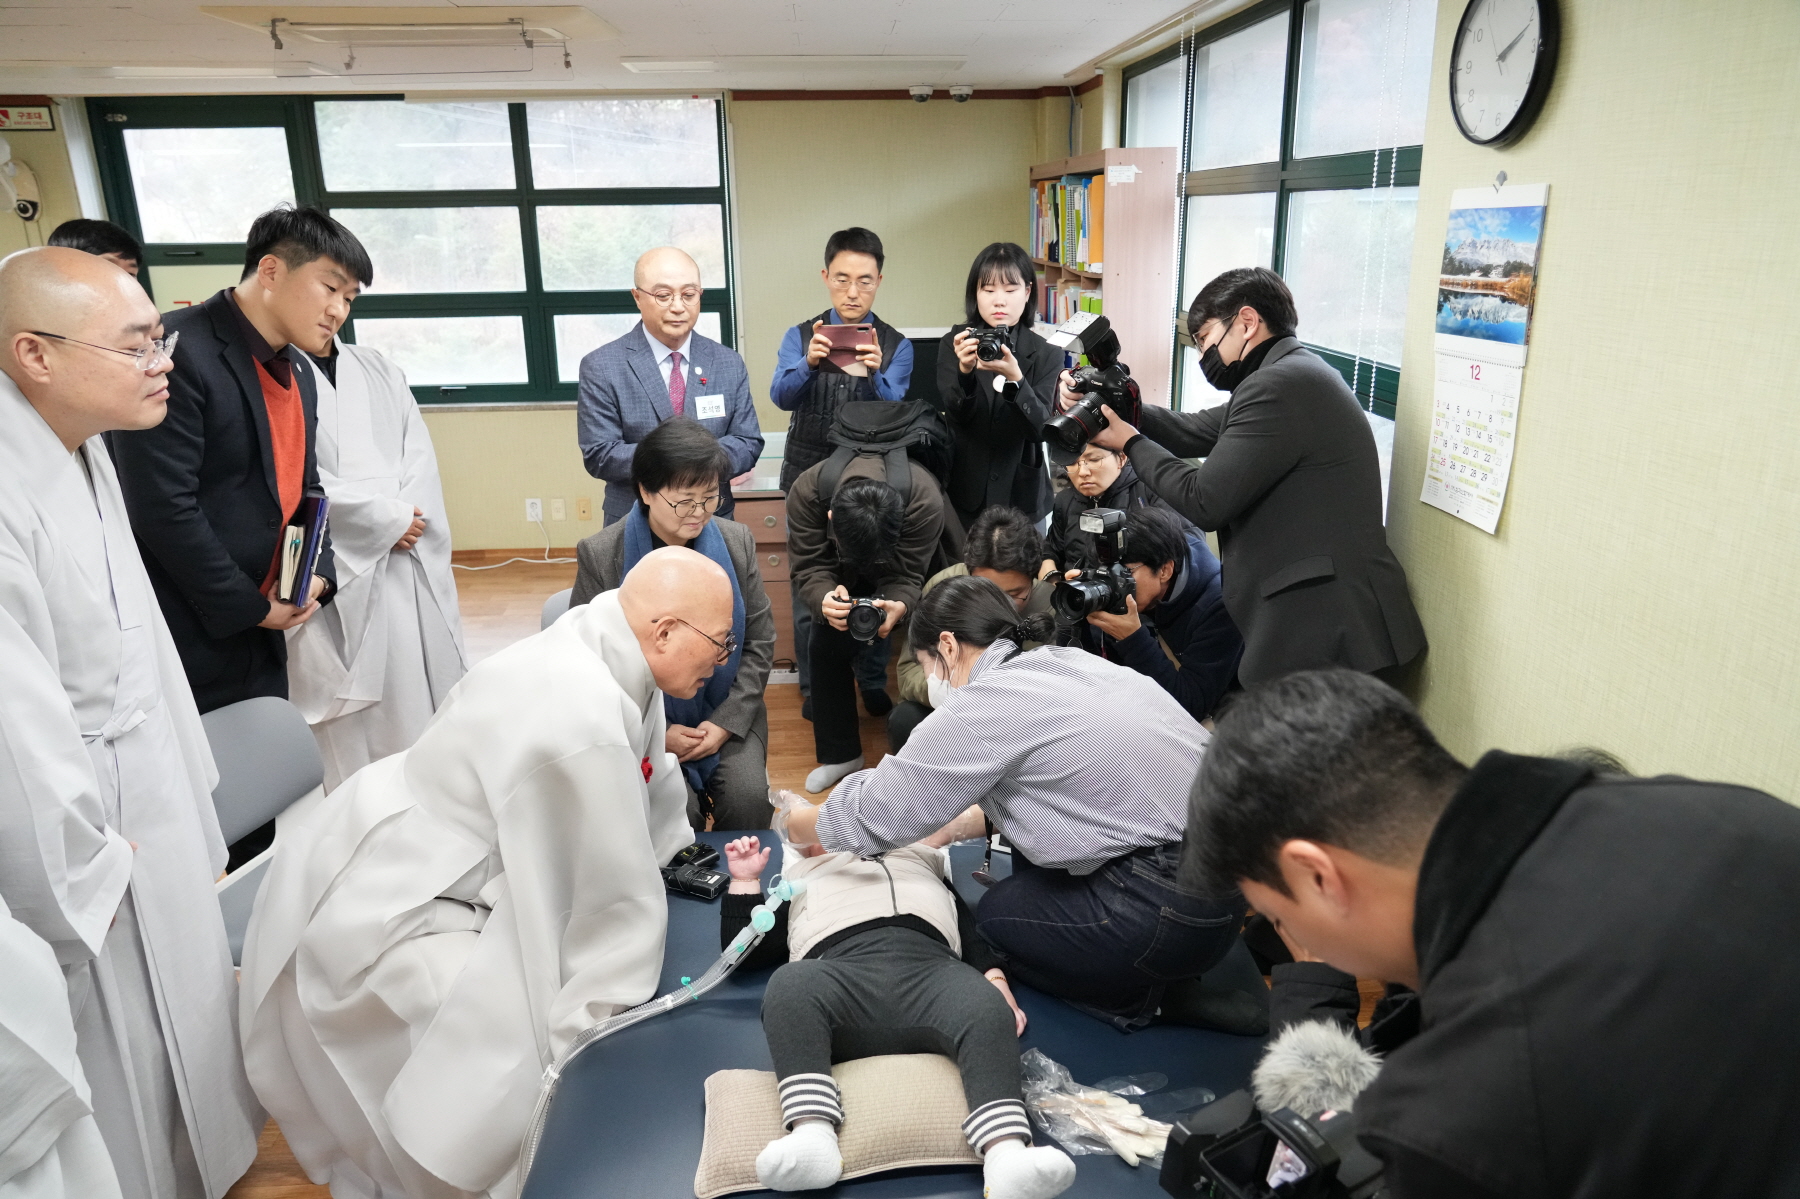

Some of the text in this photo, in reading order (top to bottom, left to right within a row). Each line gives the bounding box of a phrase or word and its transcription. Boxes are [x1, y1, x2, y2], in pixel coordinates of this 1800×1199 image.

[1530, 7, 1535, 22] 2
[1473, 29, 1483, 44] 10
[1531, 38, 1536, 53] 3
[1466, 61, 1472, 74] 9
[1468, 89, 1474, 103] 8
[17, 112, 42, 120] 구조대
[1480, 110, 1485, 123] 7
[1495, 113, 1500, 126] 6
[1470, 364, 1481, 380] 12
[1443, 440, 1447, 448] 18
[1453, 443, 1458, 451] 19
[1463, 446, 1469, 455] 20
[1473, 450, 1479, 458] 21
[1484, 453, 1491, 463] 22
[1450, 461, 1456, 470] 26
[1460, 465, 1466, 473] 27
[1470, 469, 1476, 478] 28
[1481, 473, 1487, 481] 29
